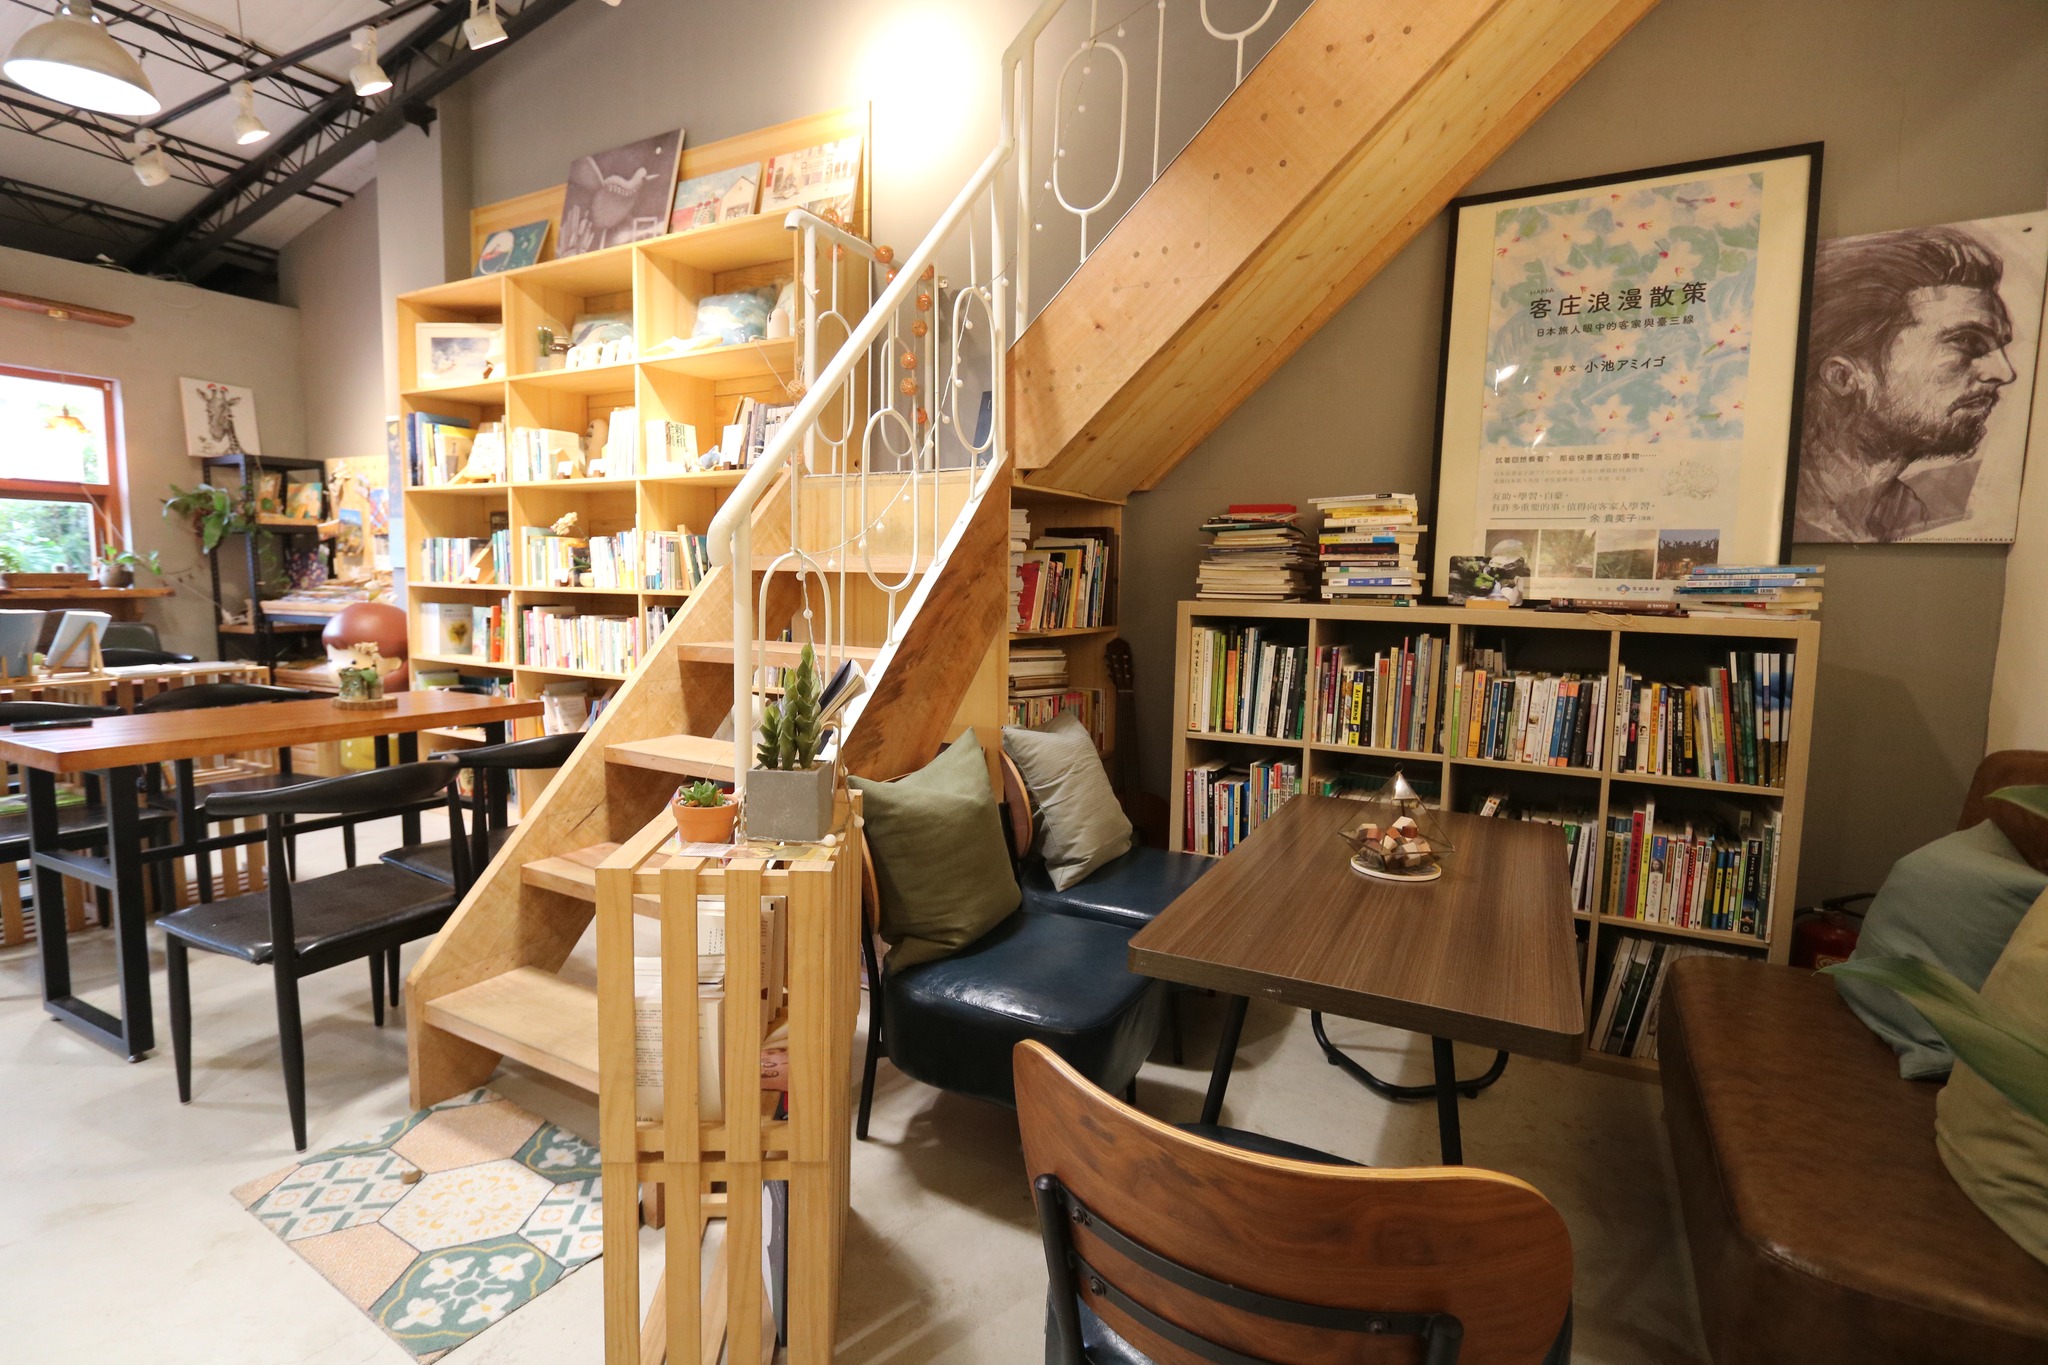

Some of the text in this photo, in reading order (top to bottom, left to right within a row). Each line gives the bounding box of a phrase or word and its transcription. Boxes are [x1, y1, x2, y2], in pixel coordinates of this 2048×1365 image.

[1529, 281, 1708, 319] 客庄浪漫散策
[1530, 287, 1555, 296] HAKKA
[1537, 314, 1694, 337] 日本旅人眼中的客家與臺三線
[1584, 355, 1667, 373] 小池アミイゴ
